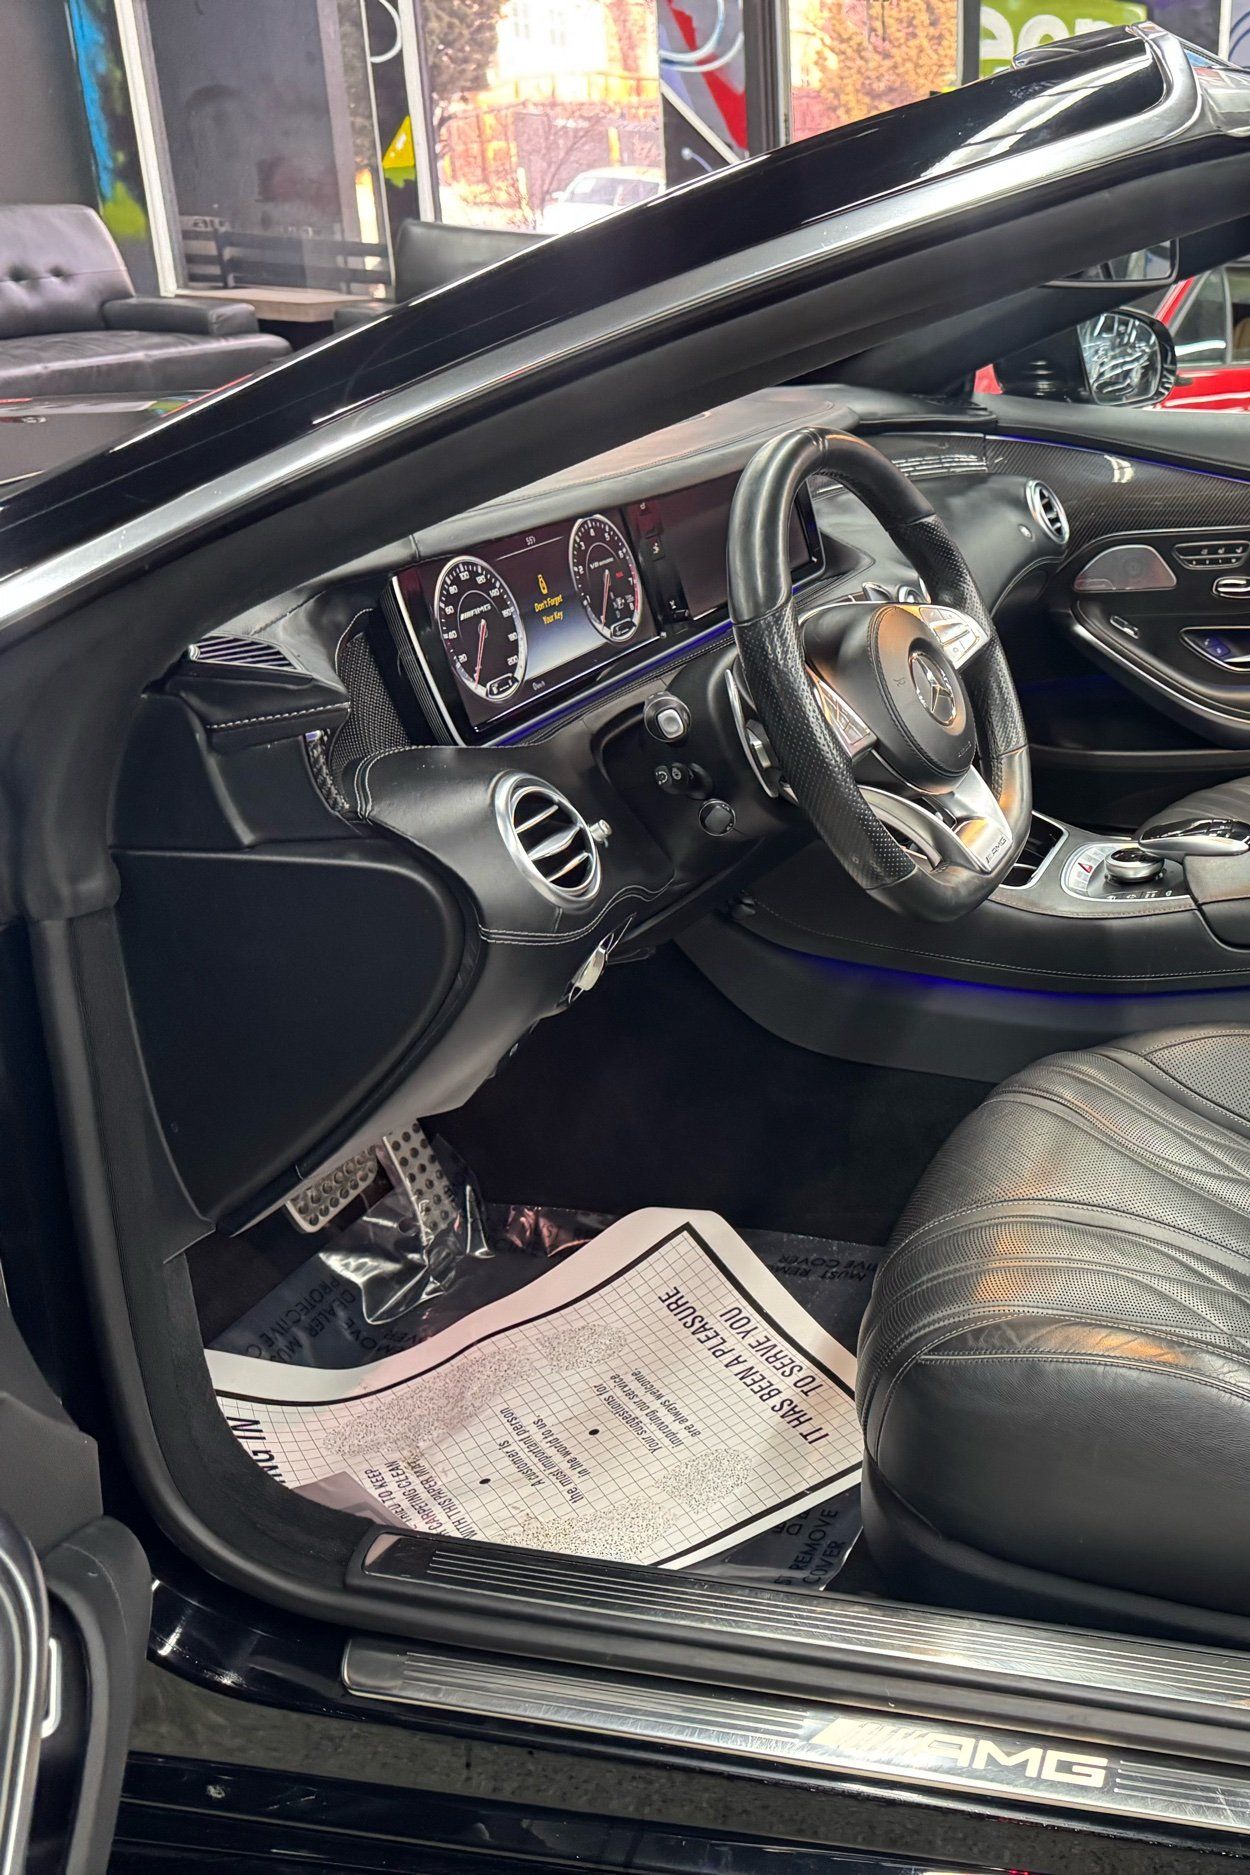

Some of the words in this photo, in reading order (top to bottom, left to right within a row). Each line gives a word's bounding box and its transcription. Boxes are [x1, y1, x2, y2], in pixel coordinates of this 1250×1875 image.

[589, 529, 596, 537] 4
[604, 532, 611, 541] 5
[579, 541, 586, 550] 3
[578, 565, 585, 575] 2
[534, 600, 548, 612] Don't
[547, 594, 563, 606] Forget
[542, 614, 554, 625] Your
[553, 611, 564, 621] Key
[657, 1286, 736, 1360] PLEASURE
[719, 1306, 759, 1341] YOU
[723, 1353, 748, 1369] A
[747, 1334, 804, 1378] SERVE
[593, 1383, 611, 1397] for
[610, 1373, 639, 1401] service
[733, 1366, 783, 1403] BEEN
[792, 1374, 824, 1398] TO
[603, 1395, 648, 1437] suggestions
[632, 1398, 651, 1412] our
[660, 1399, 689, 1425] always
[770, 1397, 813, 1430] HAS
[226, 1416, 267, 1440] IN
[500, 1407, 530, 1437] person
[645, 1409, 685, 1449] improving
[683, 1423, 702, 1438] are
[498, 1439, 512, 1451] is
[541, 1429, 556, 1440] to
[642, 1435, 663, 1454] Your
[798, 1426, 830, 1445] IT
[518, 1435, 557, 1472] important
[545, 1437, 572, 1459] world
[384, 1460, 412, 1489] CLEAN
[505, 1449, 540, 1482] customer
[566, 1456, 584, 1471] the
[577, 1468, 591, 1479] in
[364, 1468, 389, 1490] KEEP
[530, 1479, 546, 1487] A
[548, 1467, 573, 1487] most
[378, 1490, 396, 1504] TO
[420, 1477, 445, 1501] PAPER
[566, 1486, 585, 1504] the
[402, 1488, 444, 1531] CARPETING
[438, 1498, 462, 1520] THIS
[452, 1517, 478, 1540] WITH
[788, 1508, 838, 1571] REMOVE
[802, 1540, 846, 1585] COVER
